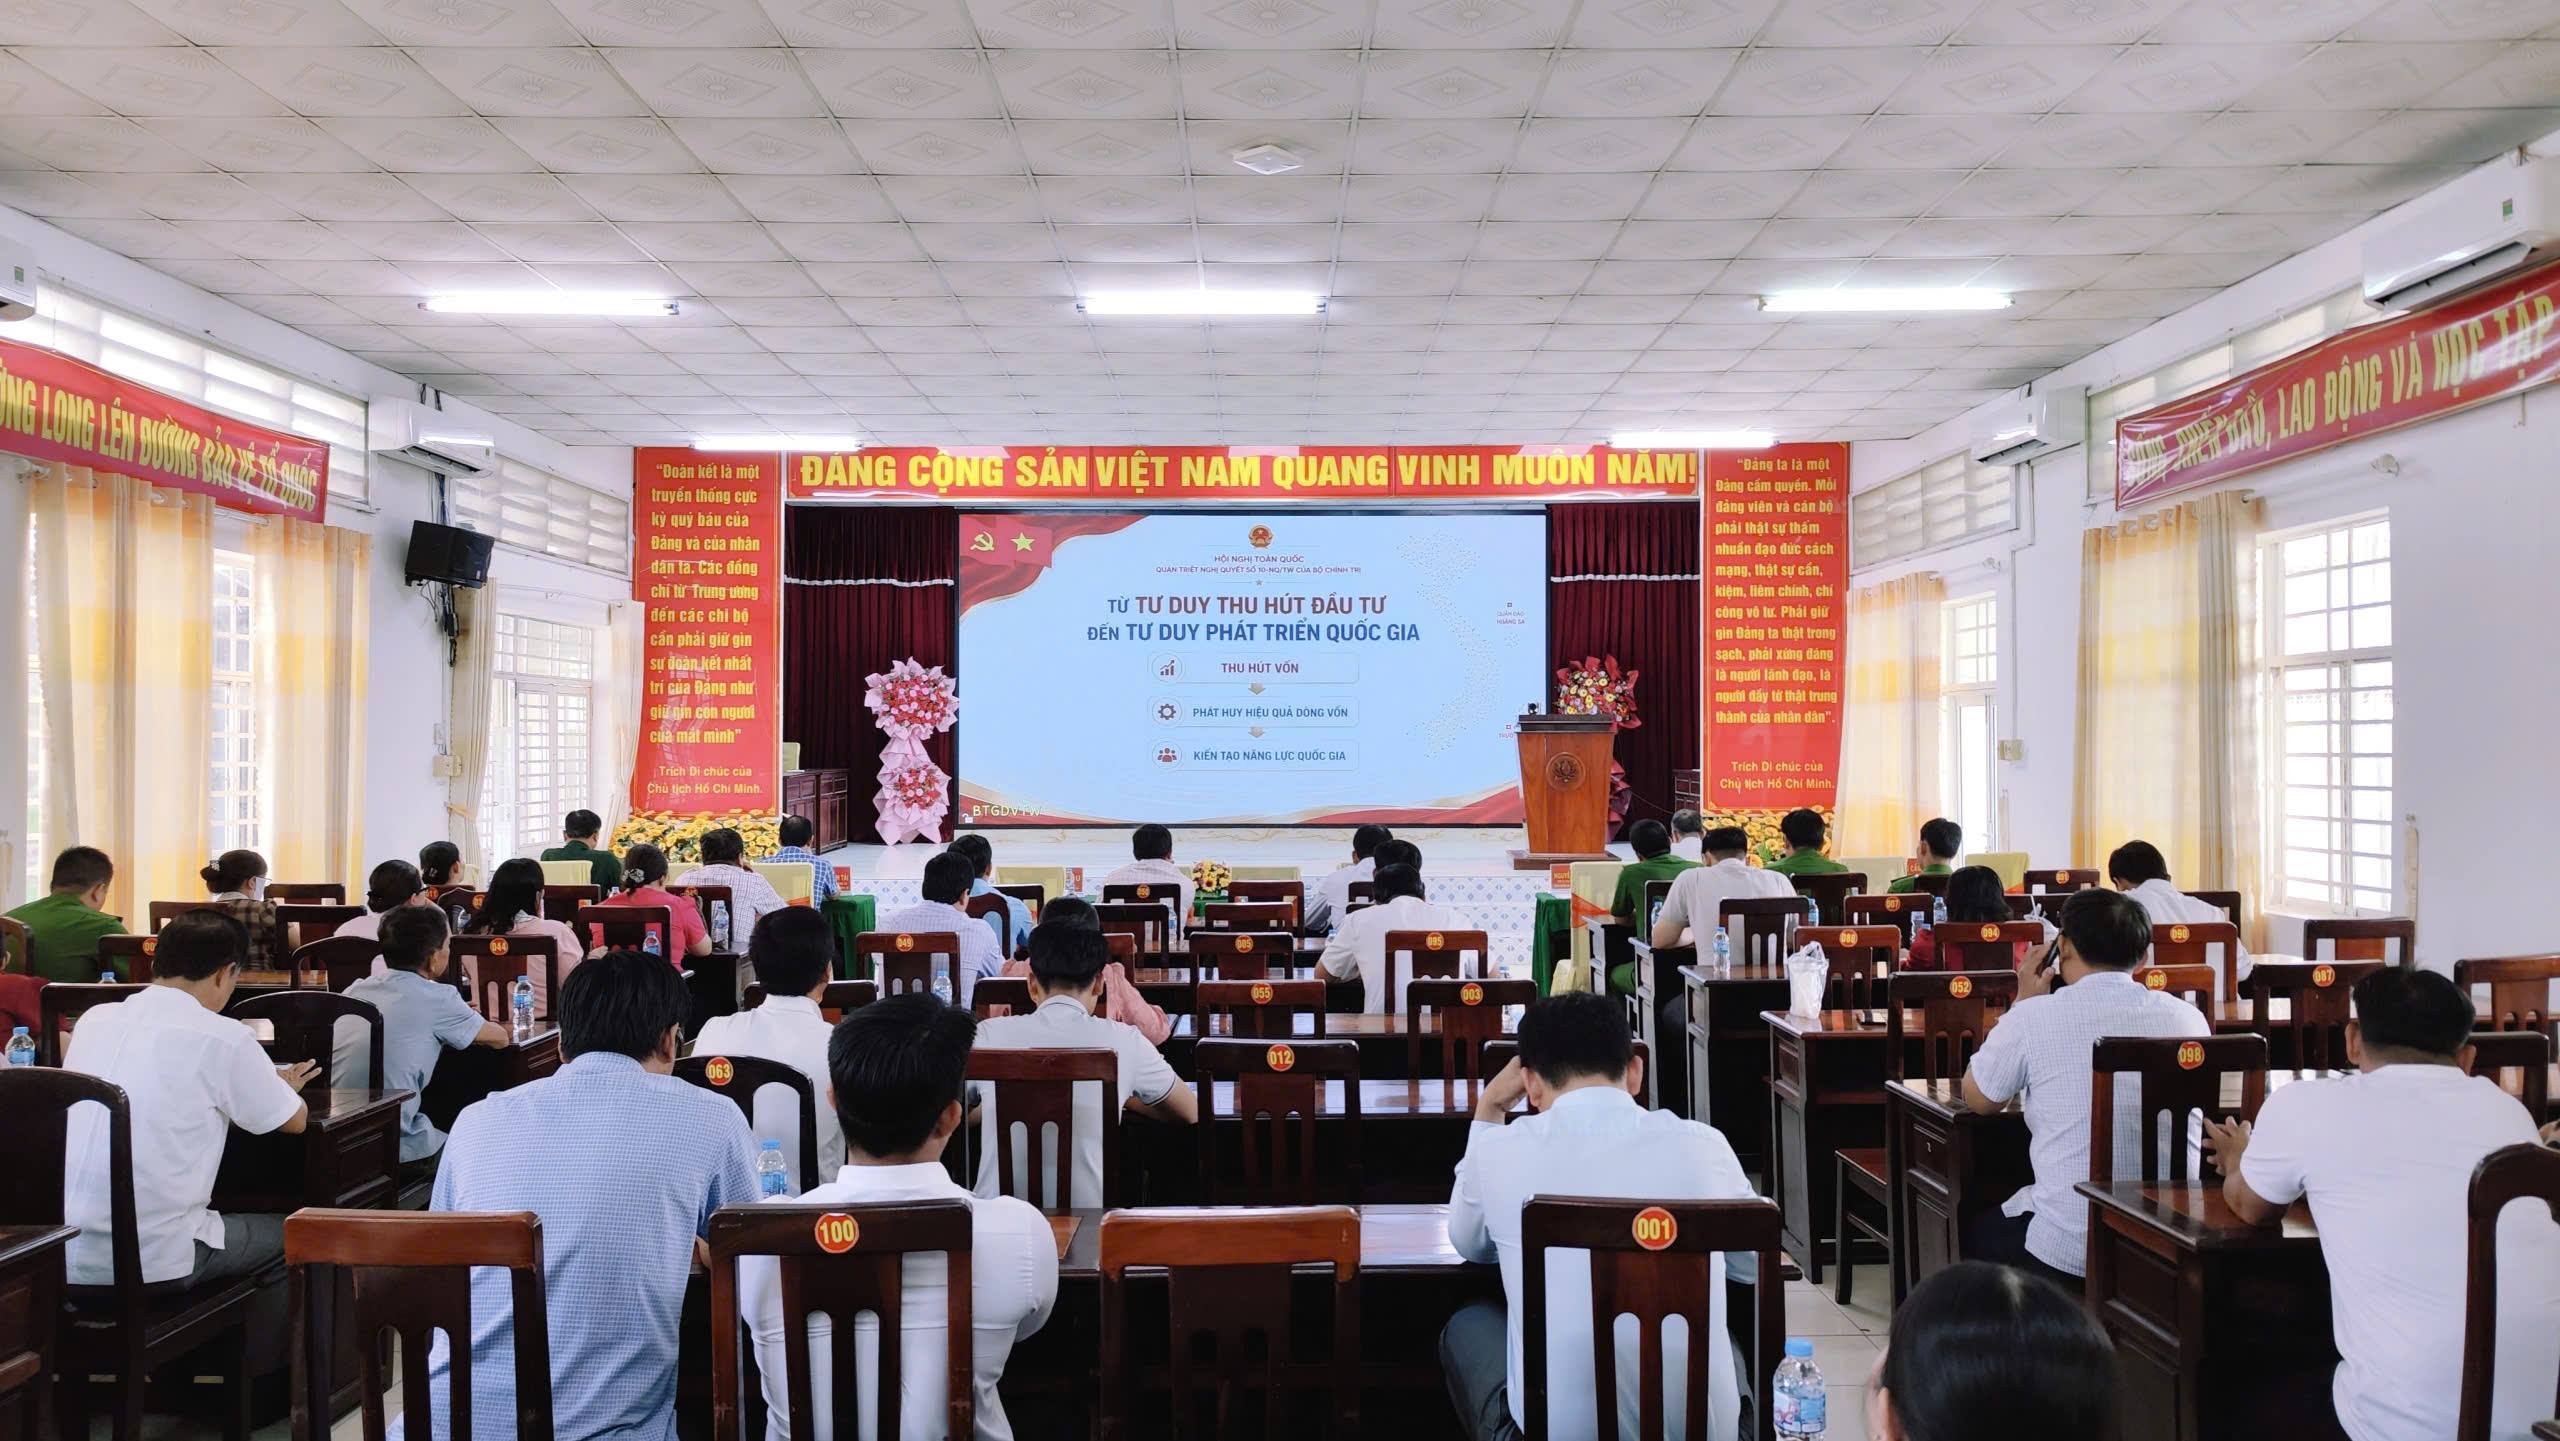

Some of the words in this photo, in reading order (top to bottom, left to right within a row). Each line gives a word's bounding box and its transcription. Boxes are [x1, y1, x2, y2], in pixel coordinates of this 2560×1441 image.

[2278, 379, 2316, 439] LAO
[2324, 354, 2382, 431] ĐỘNG
[2391, 330, 2423, 404] VÀ
[2432, 319, 2484, 397] HỌC
[2493, 291, 2554, 380] TẬP
[42, 385, 95, 450] LONG
[99, 397, 135, 462] LÊN
[139, 414, 199, 479] ĐƯỜNG
[202, 425, 236, 489] BẢO
[259, 440, 280, 497] TỔ
[908, 450, 1004, 494] CỘNG
[1015, 447, 1087, 487] SẢN
[1095, 450, 1169, 494] VIỆT
[1181, 456, 1261, 487] NAM
[1272, 455, 1389, 490] QUANG
[1398, 456, 1479, 486] VINH
[1492, 450, 1595, 486] MUÔN
[1607, 450, 1697, 486] NĂM!
[1107, 595, 1129, 613] TỪ
[1136, 595, 1164, 614] TƯ
[1169, 597, 1210, 614] DUY
[1217, 597, 1258, 614] THU
[1265, 593, 1305, 614] HÚT
[1311, 592, 1352, 614] ĐẦU
[1359, 595, 1387, 614] TƯ
[1088, 622, 1119, 640] ĐẾN
[1126, 622, 1154, 641] TƯ
[1160, 624, 1199, 640] DUY
[1207, 620, 1257, 640] PHÁT
[1264, 618, 1321, 640] TRIỂN
[1327, 618, 1381, 641] QUỐC
[1387, 624, 1420, 640] GIA
[1221, 663, 1244, 672] THU
[1249, 661, 1271, 672] HÚT
[1275, 659, 1298, 672] VỐN
[1193, 706, 1218, 717] PHÁT
[1222, 709, 1242, 717] HUY
[1246, 707, 1269, 718] HIỆU
[1272, 706, 1292, 718] QUẢ
[1296, 706, 1324, 717] DÒNG
[1328, 705, 1348, 716] VỐN
[1194, 749, 1217, 760] KIẾN
[1221, 752, 1240, 762] TẠO
[1243, 750, 1271, 760] NĂNG
[1275, 750, 1294, 762] LỰC
[1298, 749, 1325, 761] QUỐC
[1329, 752, 1346, 760] GIA
[896, 939, 912, 947] 049
[1253, 989, 1270, 998] 055
[1952, 983, 1970, 991] 052
[1462, 990, 1481, 999] 003
[1270, 1051, 1292, 1064] 012
[2180, 1050, 2202, 1062] 098
[708, 1066, 731, 1079] 063
[821, 1221, 855, 1243] 100
[1637, 1218, 1671, 1240] 001
